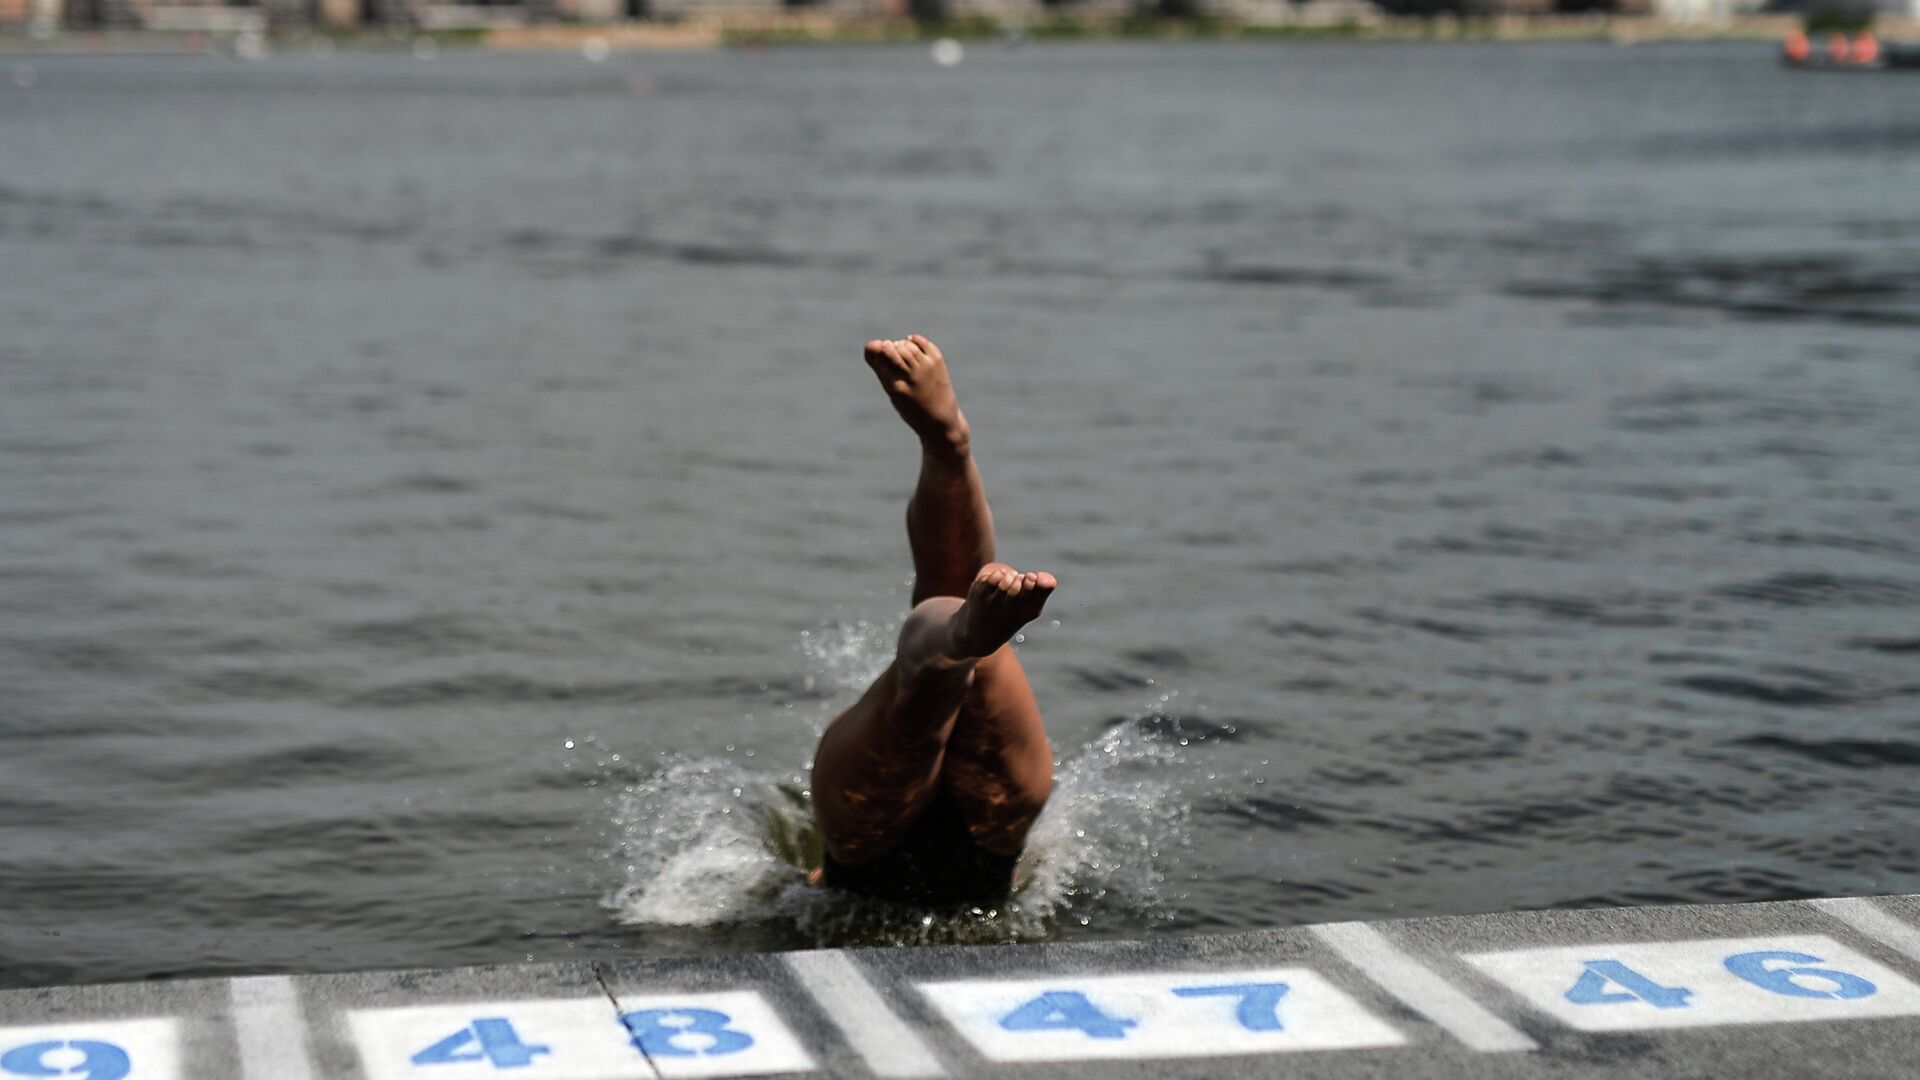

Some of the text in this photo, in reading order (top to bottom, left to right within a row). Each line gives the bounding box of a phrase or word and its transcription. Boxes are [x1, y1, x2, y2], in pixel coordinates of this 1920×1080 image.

[1566, 951, 1877, 1007] 46
[411, 1008, 754, 1067] 48
[999, 983, 1290, 1038] 47
